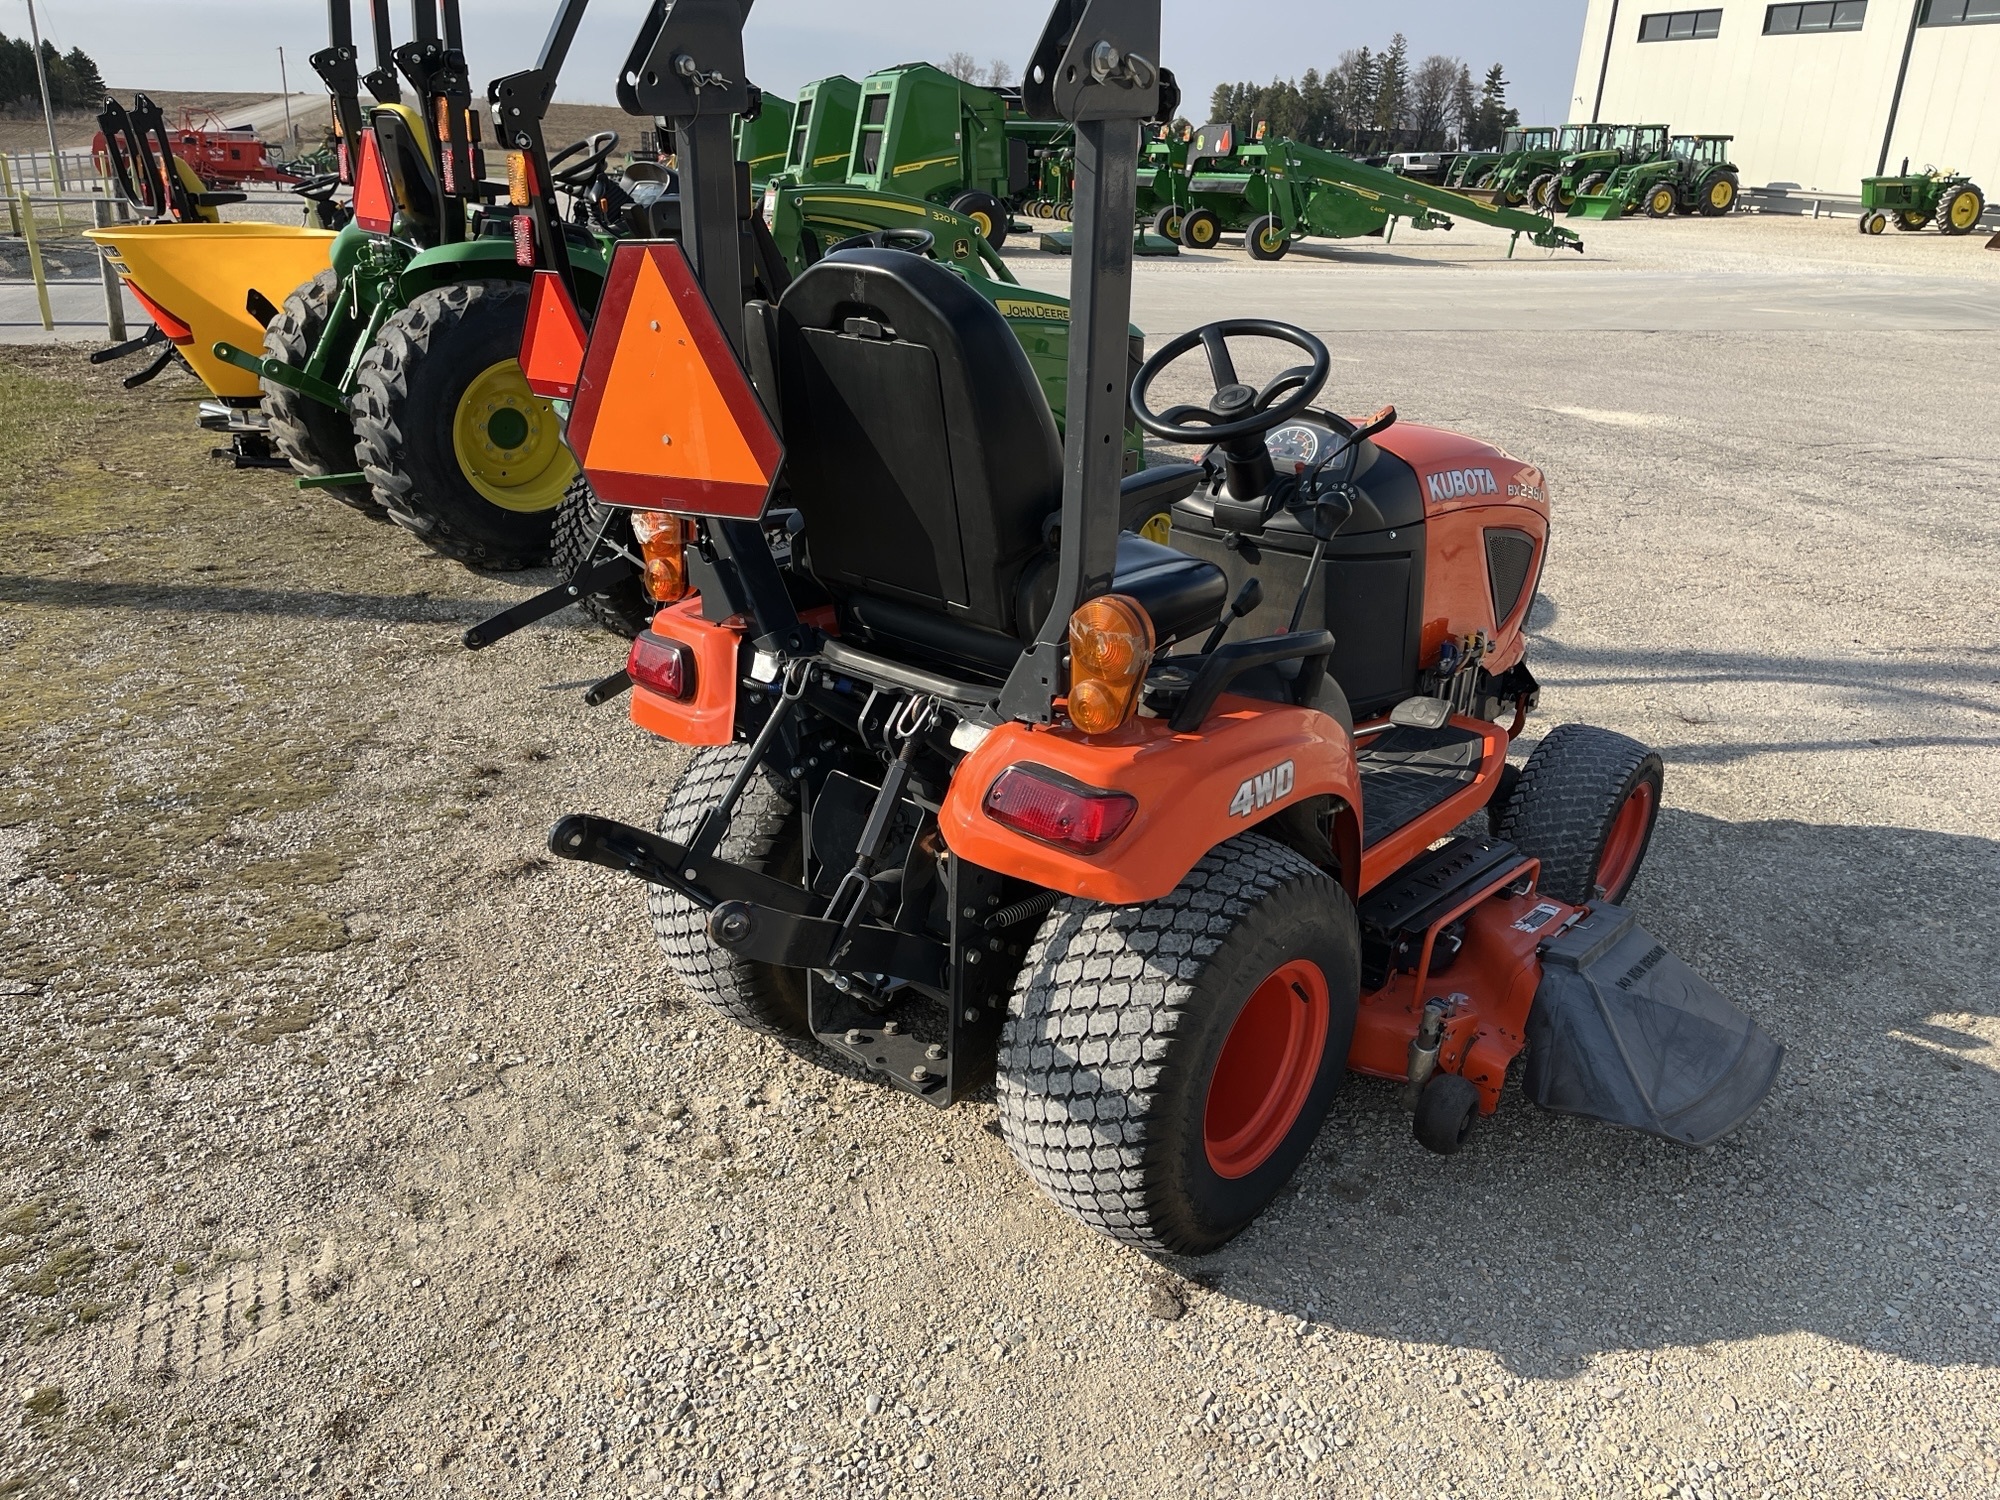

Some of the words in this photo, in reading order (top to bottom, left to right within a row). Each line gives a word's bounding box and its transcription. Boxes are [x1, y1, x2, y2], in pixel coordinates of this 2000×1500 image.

[932, 211, 951, 223] 320
[951, 216, 958, 225] R
[1007, 304, 1035, 316] JOHN
[1036, 305, 1069, 319] DEERE
[1426, 468, 1499, 502] KUBOTA
[1229, 759, 1295, 818] 4WD
